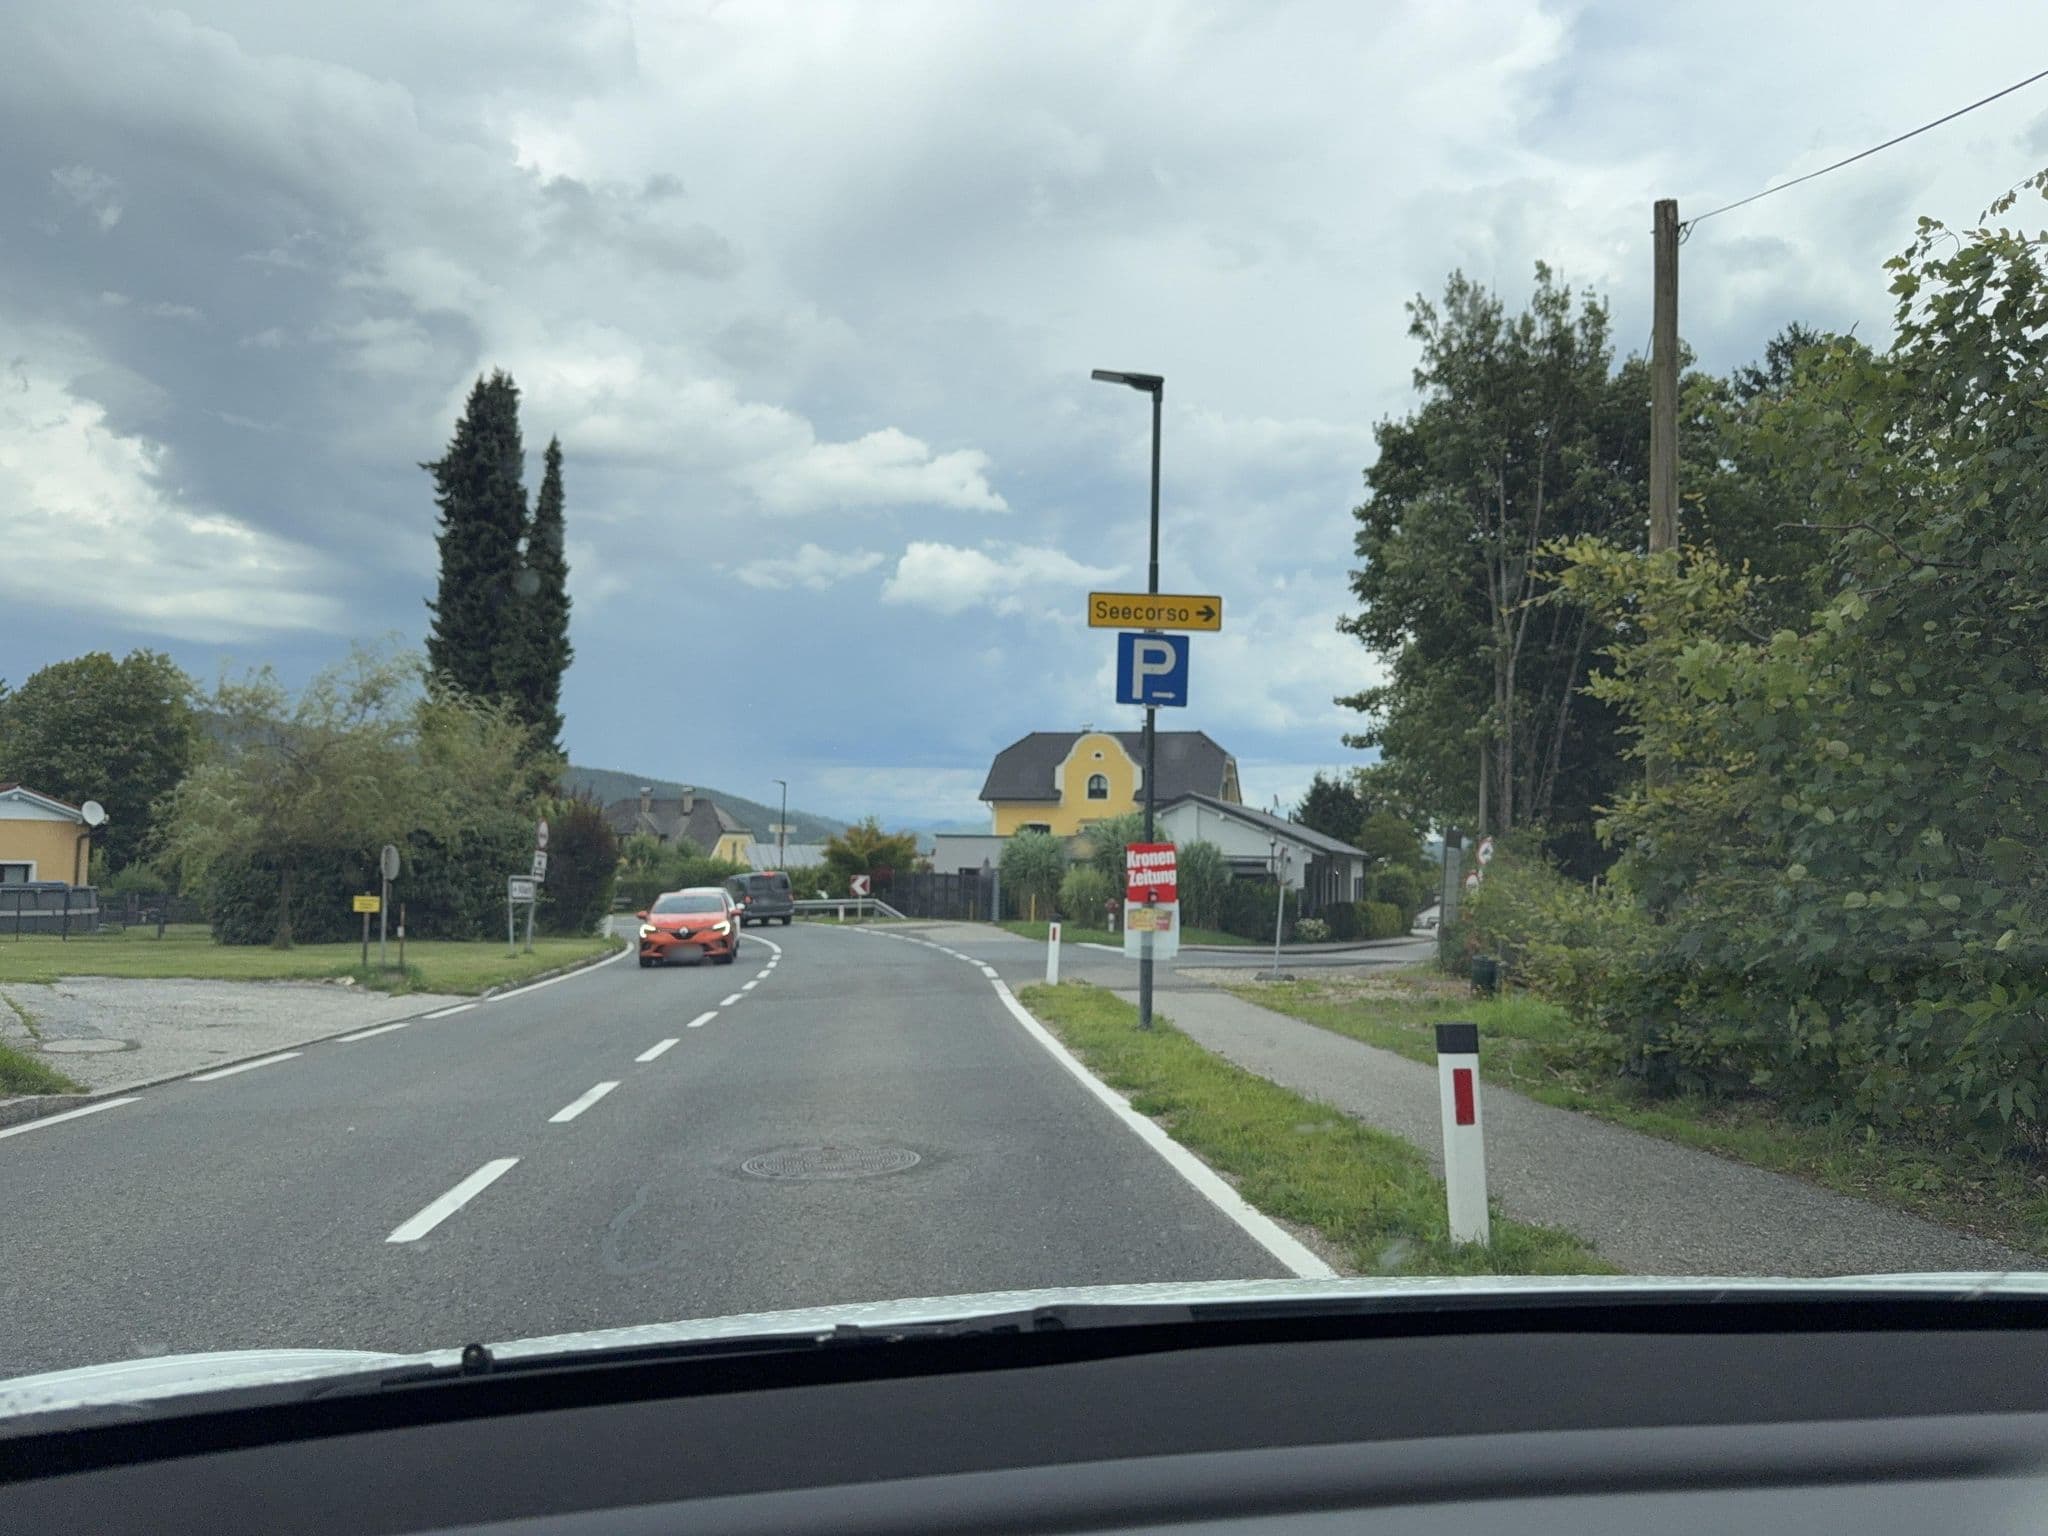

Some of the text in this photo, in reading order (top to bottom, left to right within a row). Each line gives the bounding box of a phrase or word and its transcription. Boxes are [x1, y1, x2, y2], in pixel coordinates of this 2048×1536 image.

[1096, 601, 1189, 622] Seecorso
[1132, 638, 1176, 698] P
[1127, 850, 1176, 868] Kronen
[1128, 868, 1177, 886] Zeitung
